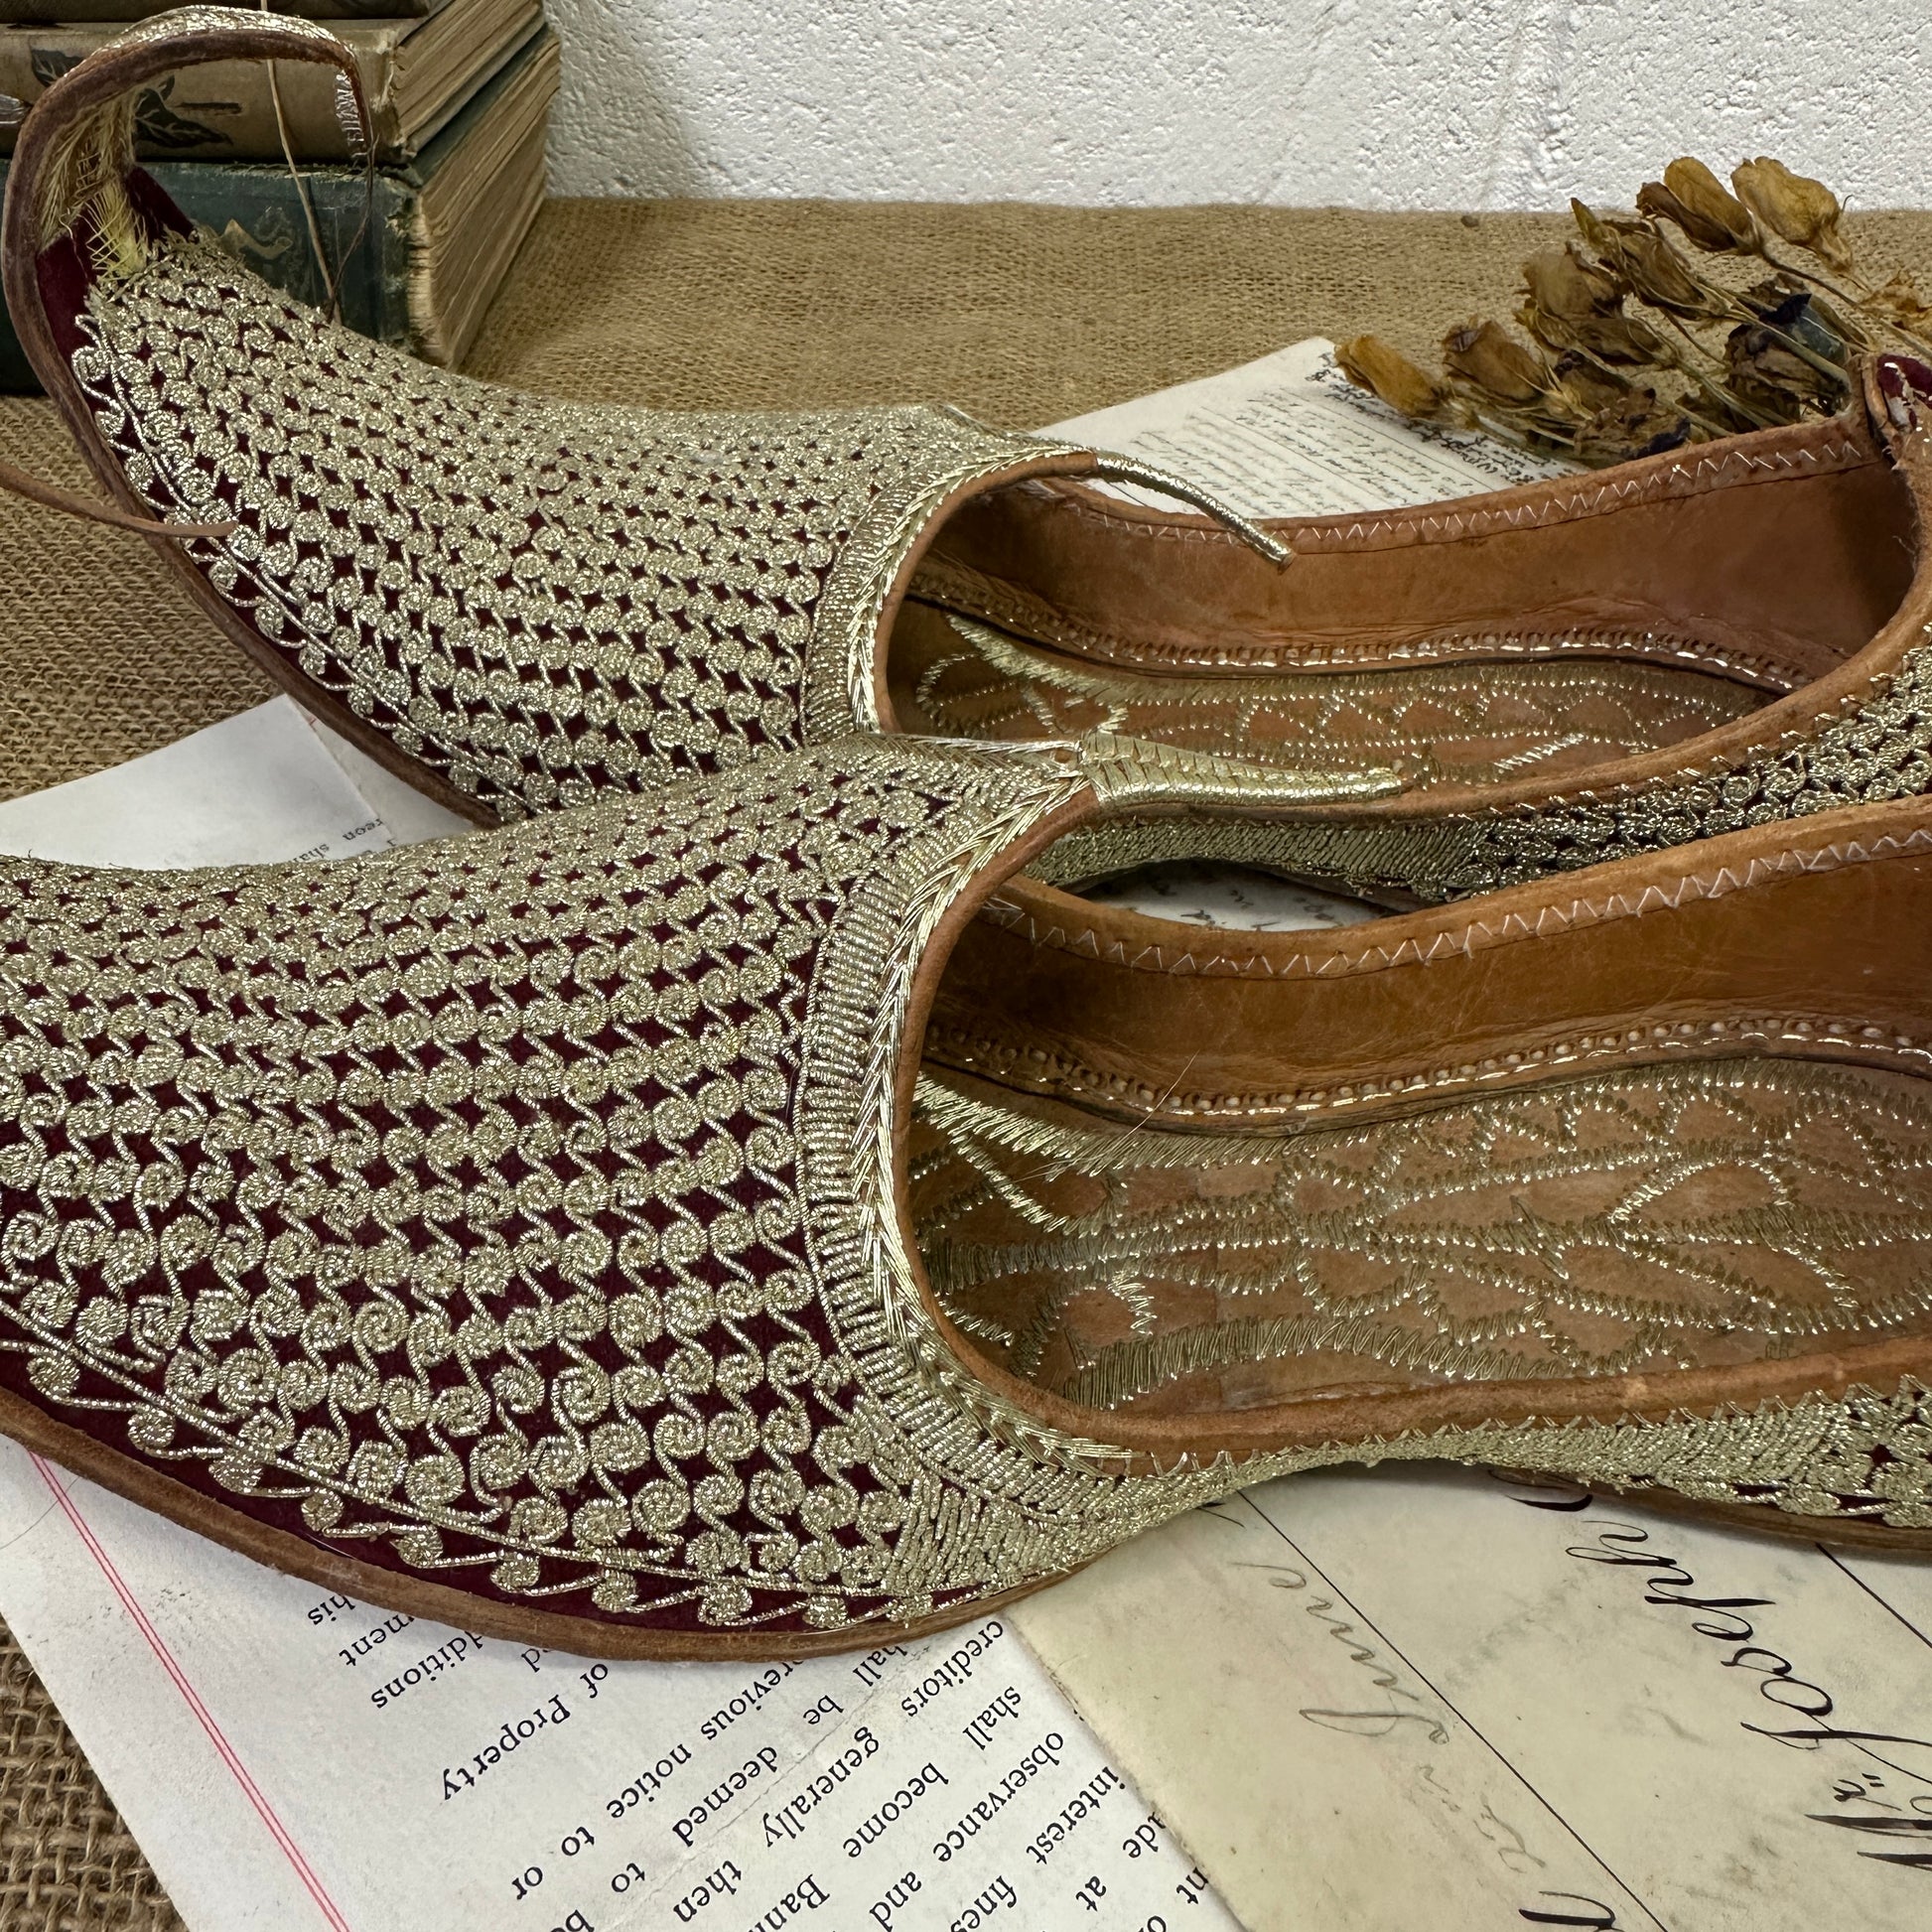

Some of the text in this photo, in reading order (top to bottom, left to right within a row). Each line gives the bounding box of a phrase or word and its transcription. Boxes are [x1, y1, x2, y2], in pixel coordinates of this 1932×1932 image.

[443, 1663, 609, 1801] of Property
[802, 1695, 844, 1725] be
[962, 1686, 1022, 1750] shall
[511, 1660, 804, 1900] revious notice to or
[672, 1746, 778, 1848] deemed
[673, 1620, 1004, 1922] creditors generally then
[842, 1762, 949, 1858] become
[1026, 1765, 1126, 1864] interest
[611, 1863, 645, 1893] to
[869, 1732, 1064, 1932] observance and
[1075, 1875, 1107, 1912] at
